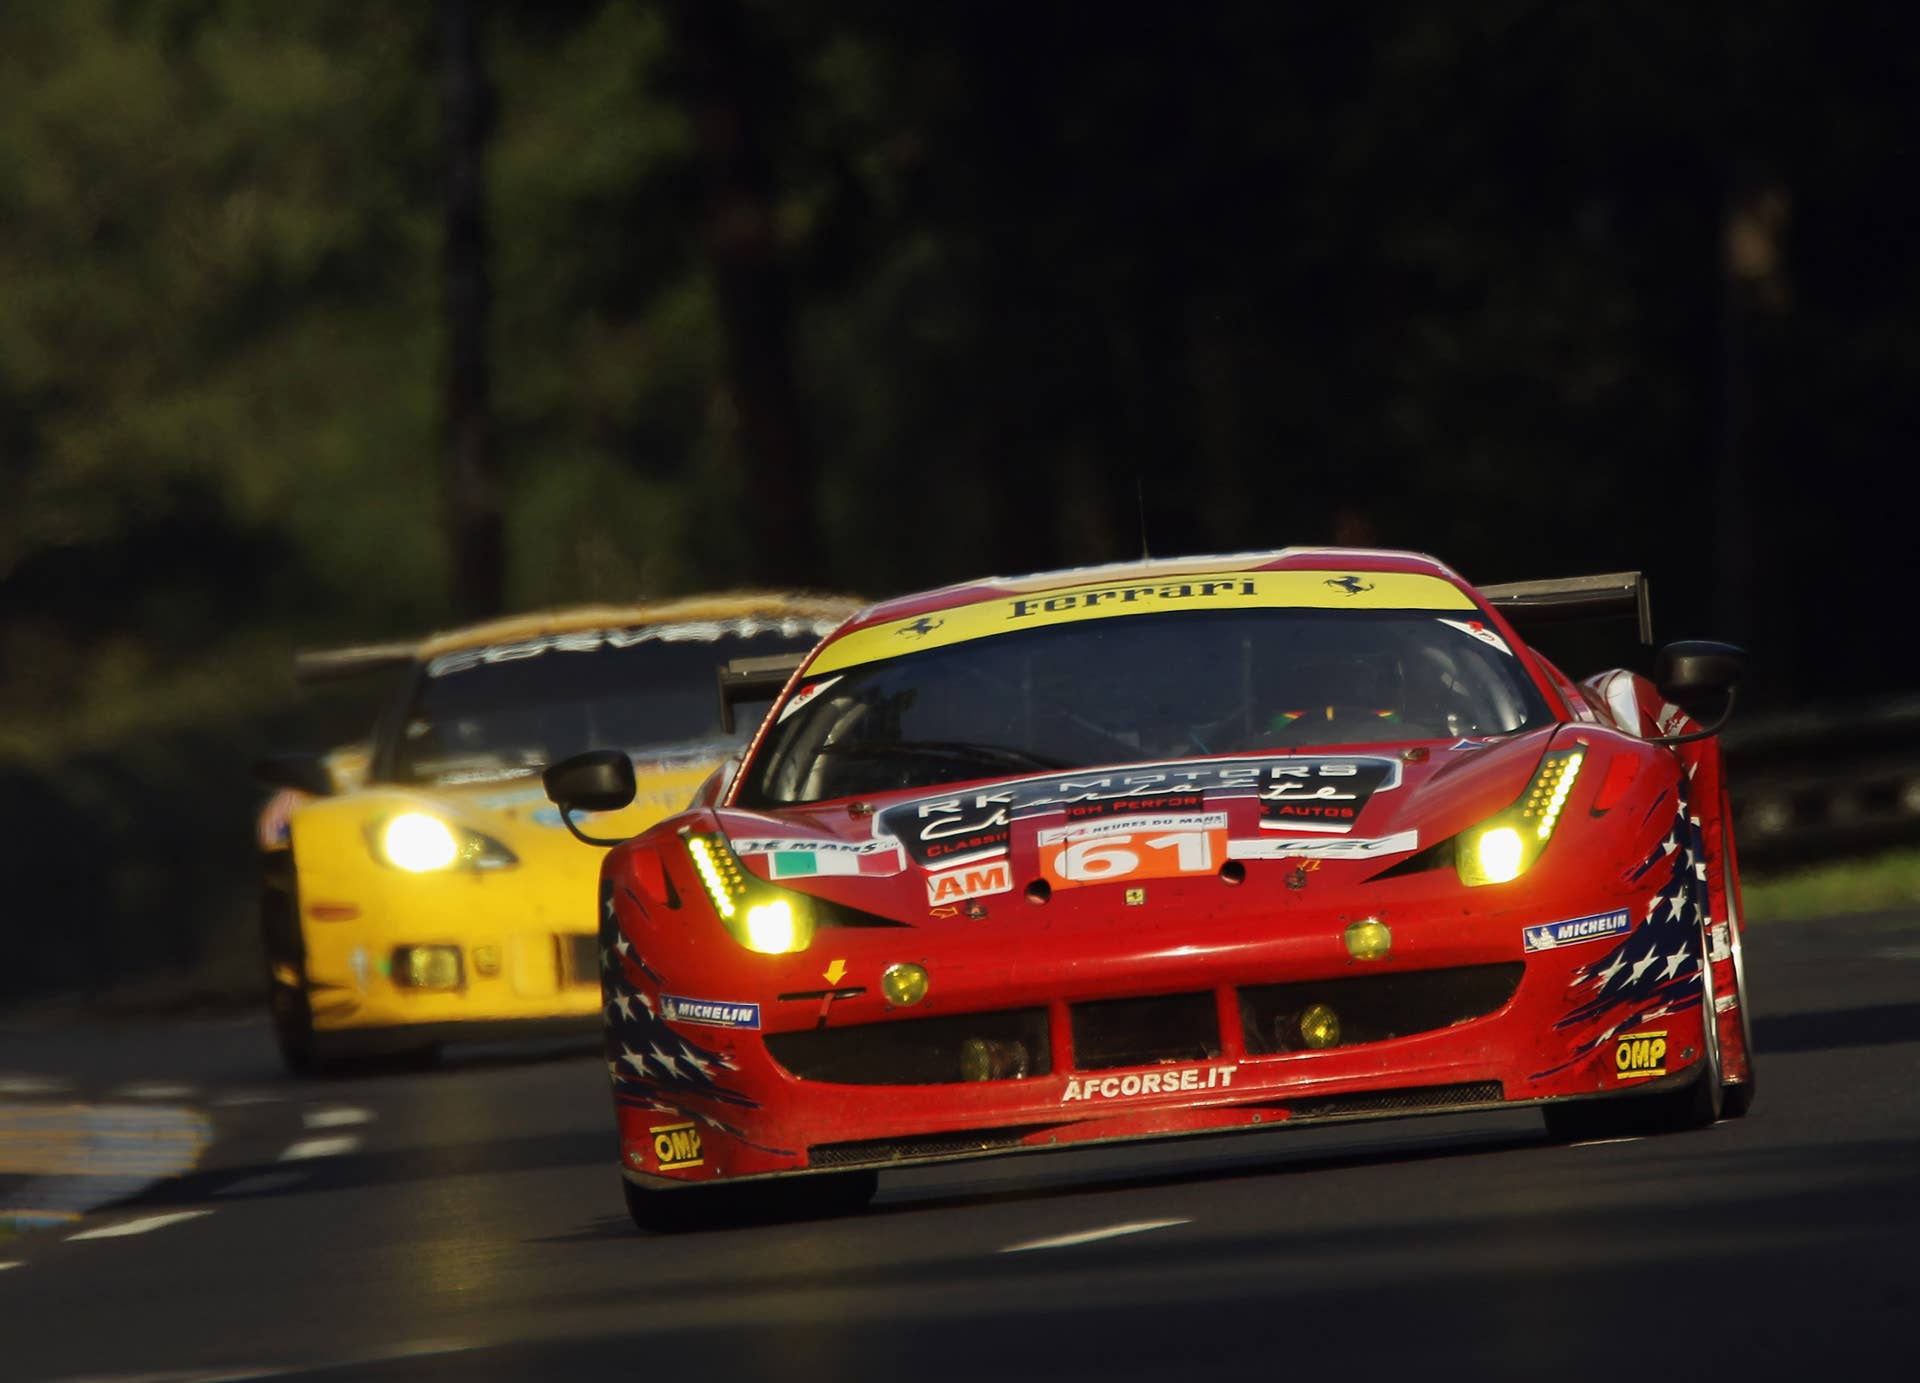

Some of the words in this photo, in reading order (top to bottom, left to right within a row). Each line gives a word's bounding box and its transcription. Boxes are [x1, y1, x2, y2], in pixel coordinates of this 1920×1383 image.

[1006, 578, 1258, 619] Ferrari
[917, 791, 1015, 818] RK
[1060, 764, 1357, 792] MOTORS
[1092, 820, 1147, 834] HEURES
[1151, 818, 1174, 826] DU
[1179, 815, 1223, 826] MANS
[1280, 806, 1354, 818] AUTOS
[790, 842, 879, 854] MANS
[1053, 832, 1213, 882] 61
[934, 867, 1006, 901] AM
[1558, 914, 1628, 940] MICHELIN
[677, 1003, 754, 1023] MICHELIN
[1615, 1038, 1667, 1071] OMP
[1062, 1066, 1238, 1102] AFCORSE.IT
[654, 1129, 702, 1162] OMP
